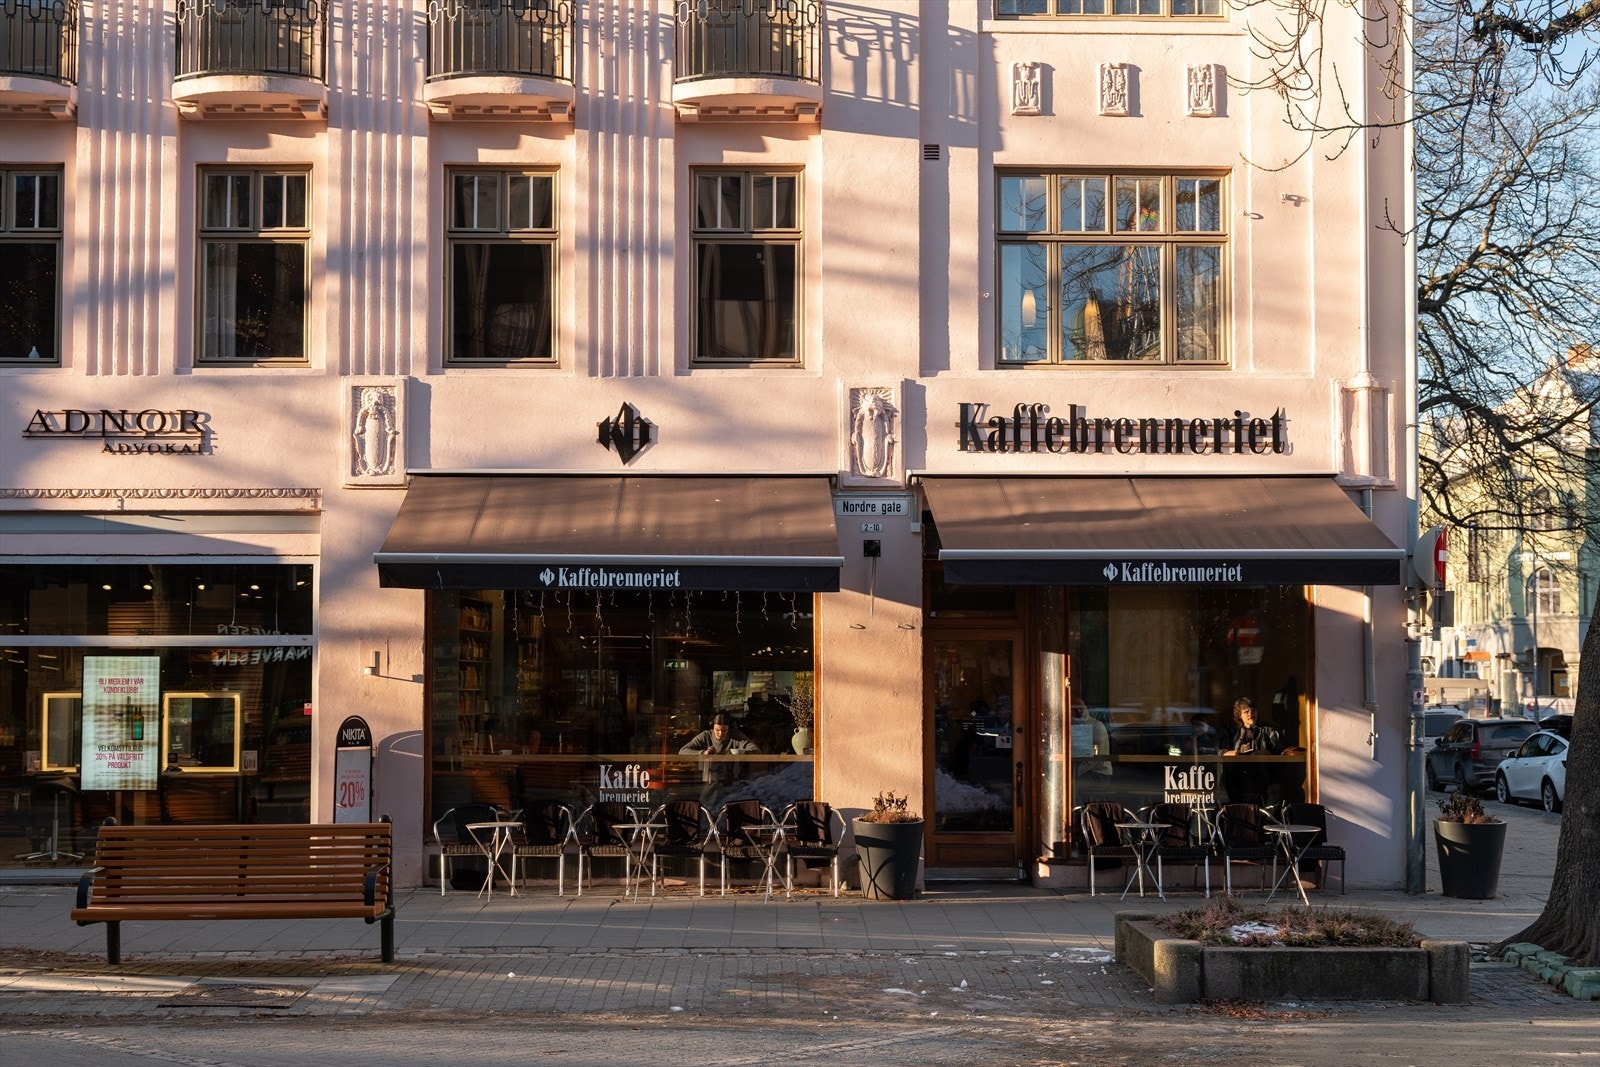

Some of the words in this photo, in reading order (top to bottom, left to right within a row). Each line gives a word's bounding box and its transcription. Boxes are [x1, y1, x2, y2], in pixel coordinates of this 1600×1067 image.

[24, 409, 205, 437] ADNOR
[958, 402, 1285, 454] Kaffebrenneriet
[102, 443, 206, 454] ADVOKAT
[843, 501, 876, 512] Nordre
[882, 502, 901, 514] gate
[558, 567, 680, 587] Kaffebrenneriet
[1122, 562, 1242, 582] Kaffebrenneriet
[134, 677, 144, 685] VÅR
[342, 728, 366, 741] NIKITA
[108, 752, 115, 760] PÅ
[600, 764, 650, 789] Kaffe
[1164, 766, 1215, 790] Kaffe
[340, 781, 365, 808] 20%
[600, 790, 650, 803] brenneriet
[1164, 791, 1215, 804] brenneriet
